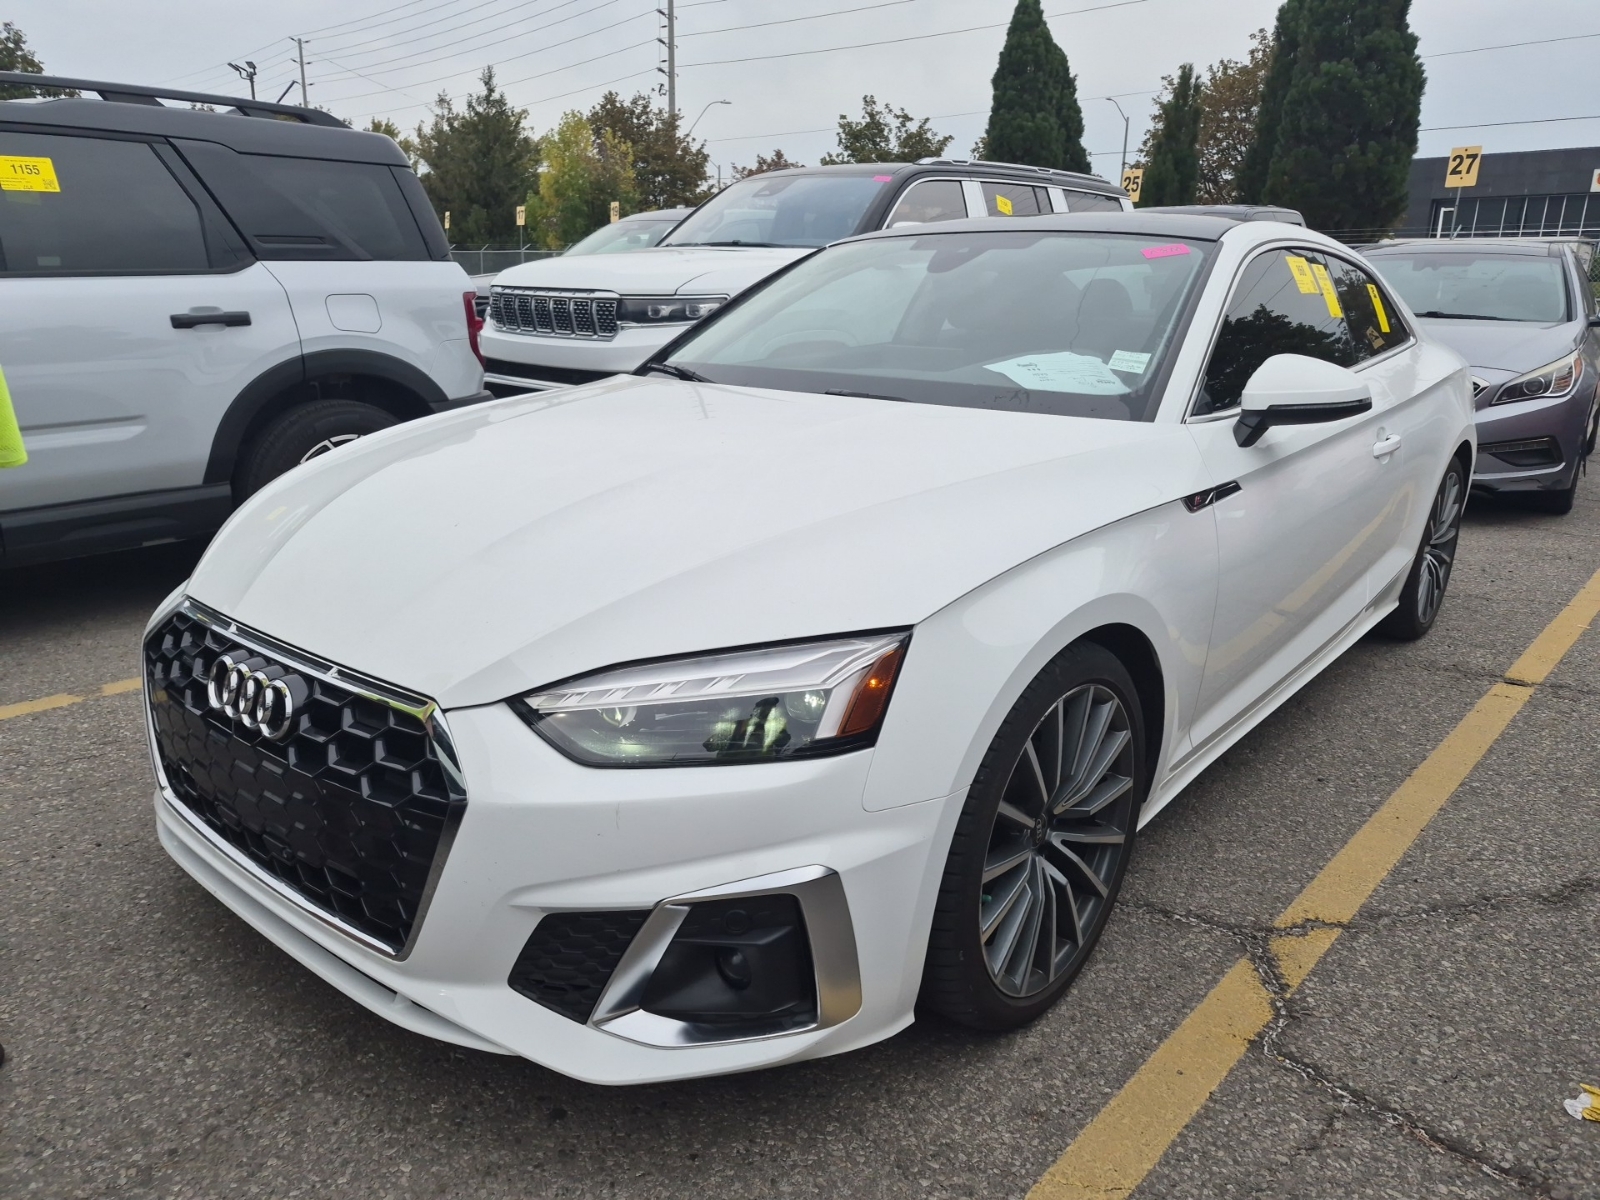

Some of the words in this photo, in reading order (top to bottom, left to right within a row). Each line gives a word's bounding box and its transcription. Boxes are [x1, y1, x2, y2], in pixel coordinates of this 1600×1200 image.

[9, 163, 41, 176] 1155
[1448, 153, 1479, 175] 27
[1123, 175, 1140, 193] 25
[517, 209, 525, 220] 17
